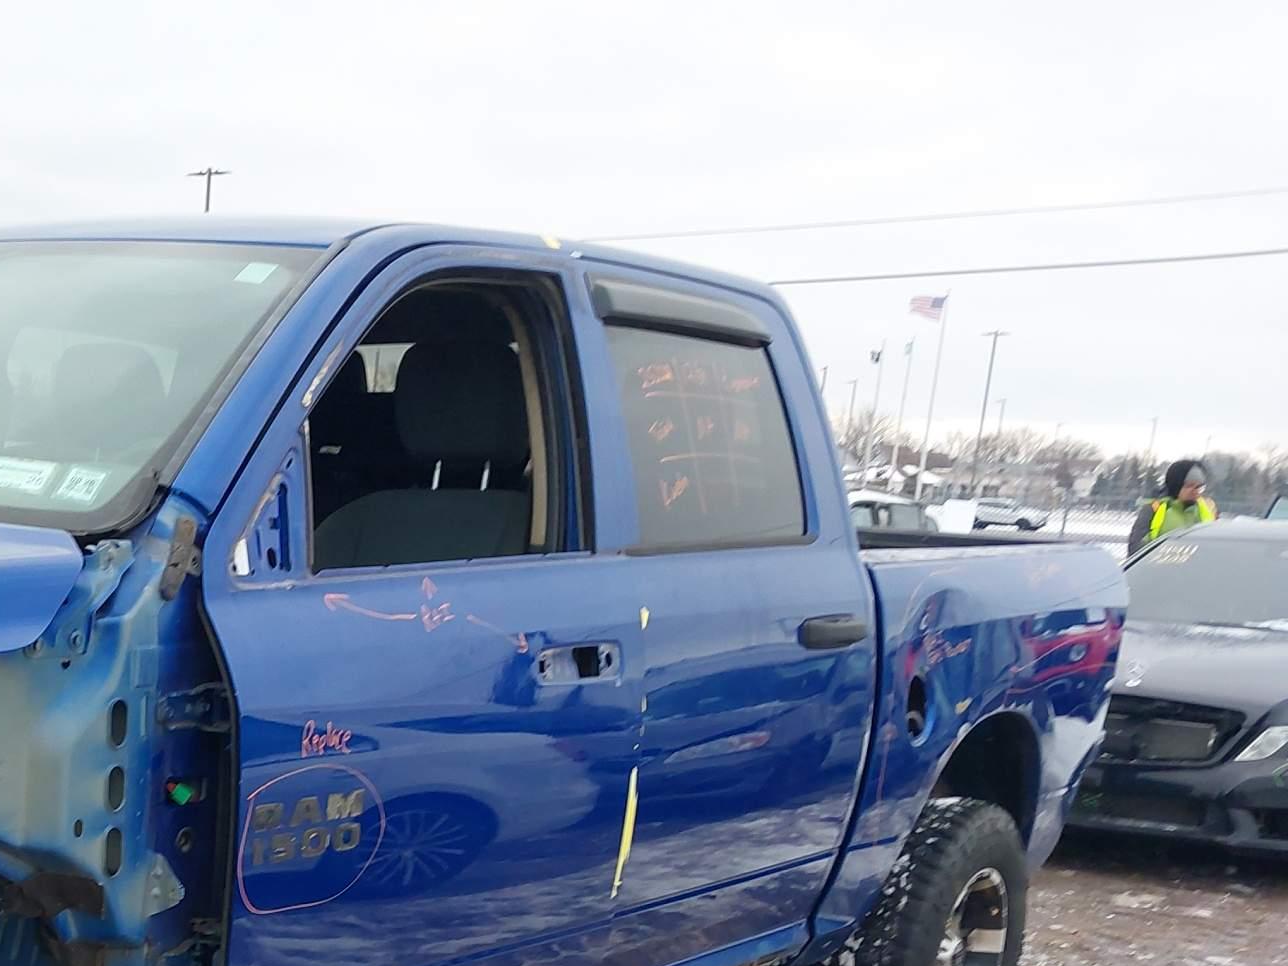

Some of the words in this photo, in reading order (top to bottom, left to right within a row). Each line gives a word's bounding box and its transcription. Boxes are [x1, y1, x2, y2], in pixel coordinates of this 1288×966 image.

[301, 719, 353, 758] Replace
[253, 788, 365, 834] RAM
[251, 821, 362, 866] 1500
